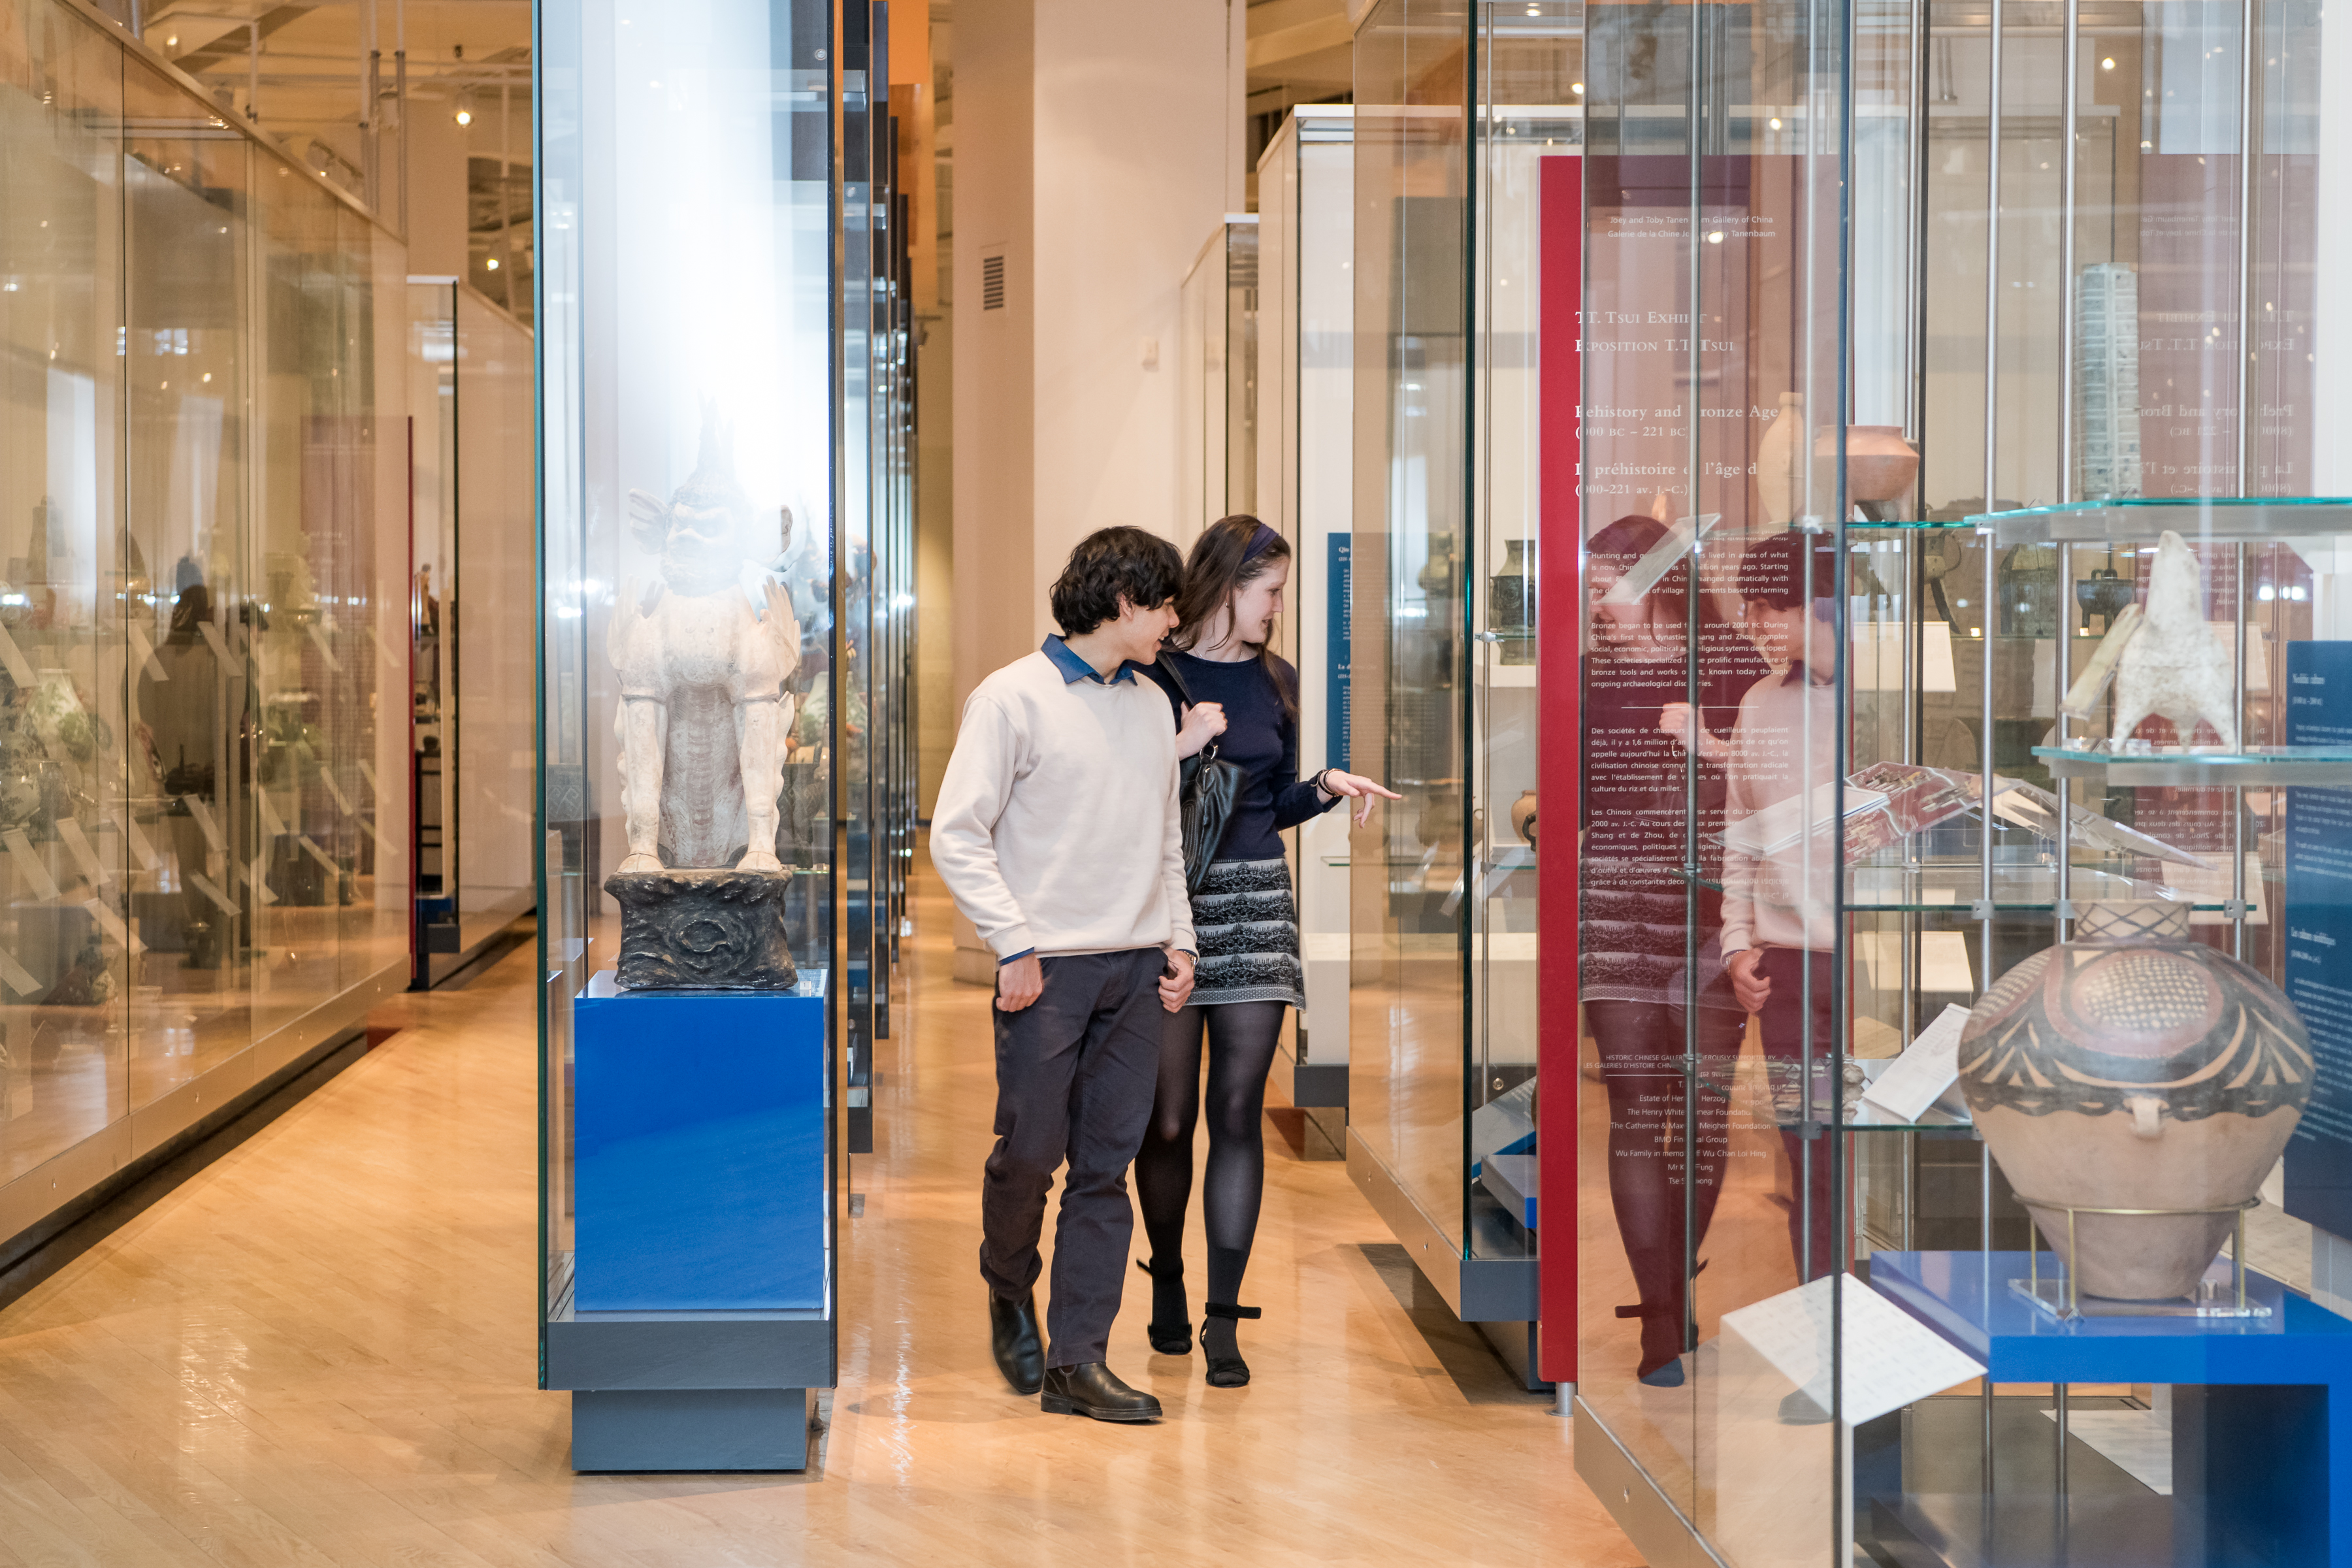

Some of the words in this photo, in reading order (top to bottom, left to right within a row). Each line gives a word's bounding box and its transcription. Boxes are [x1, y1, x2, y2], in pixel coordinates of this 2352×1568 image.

[1610, 216, 1627, 226] Joey
[1629, 216, 1644, 224] and
[1646, 216, 1664, 226] Toby
[1712, 216, 1740, 226] Gallery
[1741, 216, 1750, 224] of
[1751, 216, 1773, 224] China
[1637, 229, 1648, 238] de
[1649, 229, 1657, 238] la
[1658, 229, 1680, 238] Chine
[1731, 229, 1776, 238] Tanenbaum
[1654, 404, 1682, 418] and
[1748, 405, 1778, 421] Age
[1642, 427, 1667, 437] 221
[1594, 462, 1676, 480] préhistoire
[1637, 485, 1652, 495] av.
[1591, 551, 1620, 562] Hunting
[1721, 564, 1740, 573] years
[1742, 564, 1758, 573] ago.
[1760, 563, 1789, 573] Starting
[1727, 574, 1769, 584] dramatically
[1661, 587, 1684, 596] village
[1760, 586, 1789, 595] farming
[1618, 622, 1641, 631] began
[1764, 621, 1788, 630] During
[1655, 633, 1687, 642] dynasties
[1735, 633, 1756, 642] Zhou,
[1759, 633, 1789, 642] complex
[1650, 645, 1678, 654] political
[1750, 645, 1788, 654] developed.
[1644, 657, 1682, 666] specialized
[1707, 656, 1732, 665] prolific
[1736, 668, 1757, 677] today
[1759, 667, 1789, 677] through
[1591, 679, 1621, 689] ongoing
[1622, 679, 1672, 689] archaeological
[1750, 727, 1789, 735] peuplaient
[1591, 739, 1609, 747] déjà,
[1718, 738, 1743, 747] régions
[1591, 751, 1618, 759] appelle
[1742, 773, 1777, 781] pratiquait
[1591, 832, 1614, 840] Shang
[1644, 831, 1665, 840] Zhou,
[1591, 843, 1639, 852] économiques,
[1642, 843, 1677, 852] politiques
[1631, 855, 1678, 864] spécialisèrent
[1591, 878, 1610, 887] grâce
[1701, 1094, 1725, 1103] Herzog
[1641, 1109, 1663, 1118] Henry
[1699, 1122, 1730, 1132] Meighen
[1706, 1135, 1728, 1145] Group
[1629, 1149, 1652, 1159] Family
[1750, 1150, 1767, 1159] Hing
